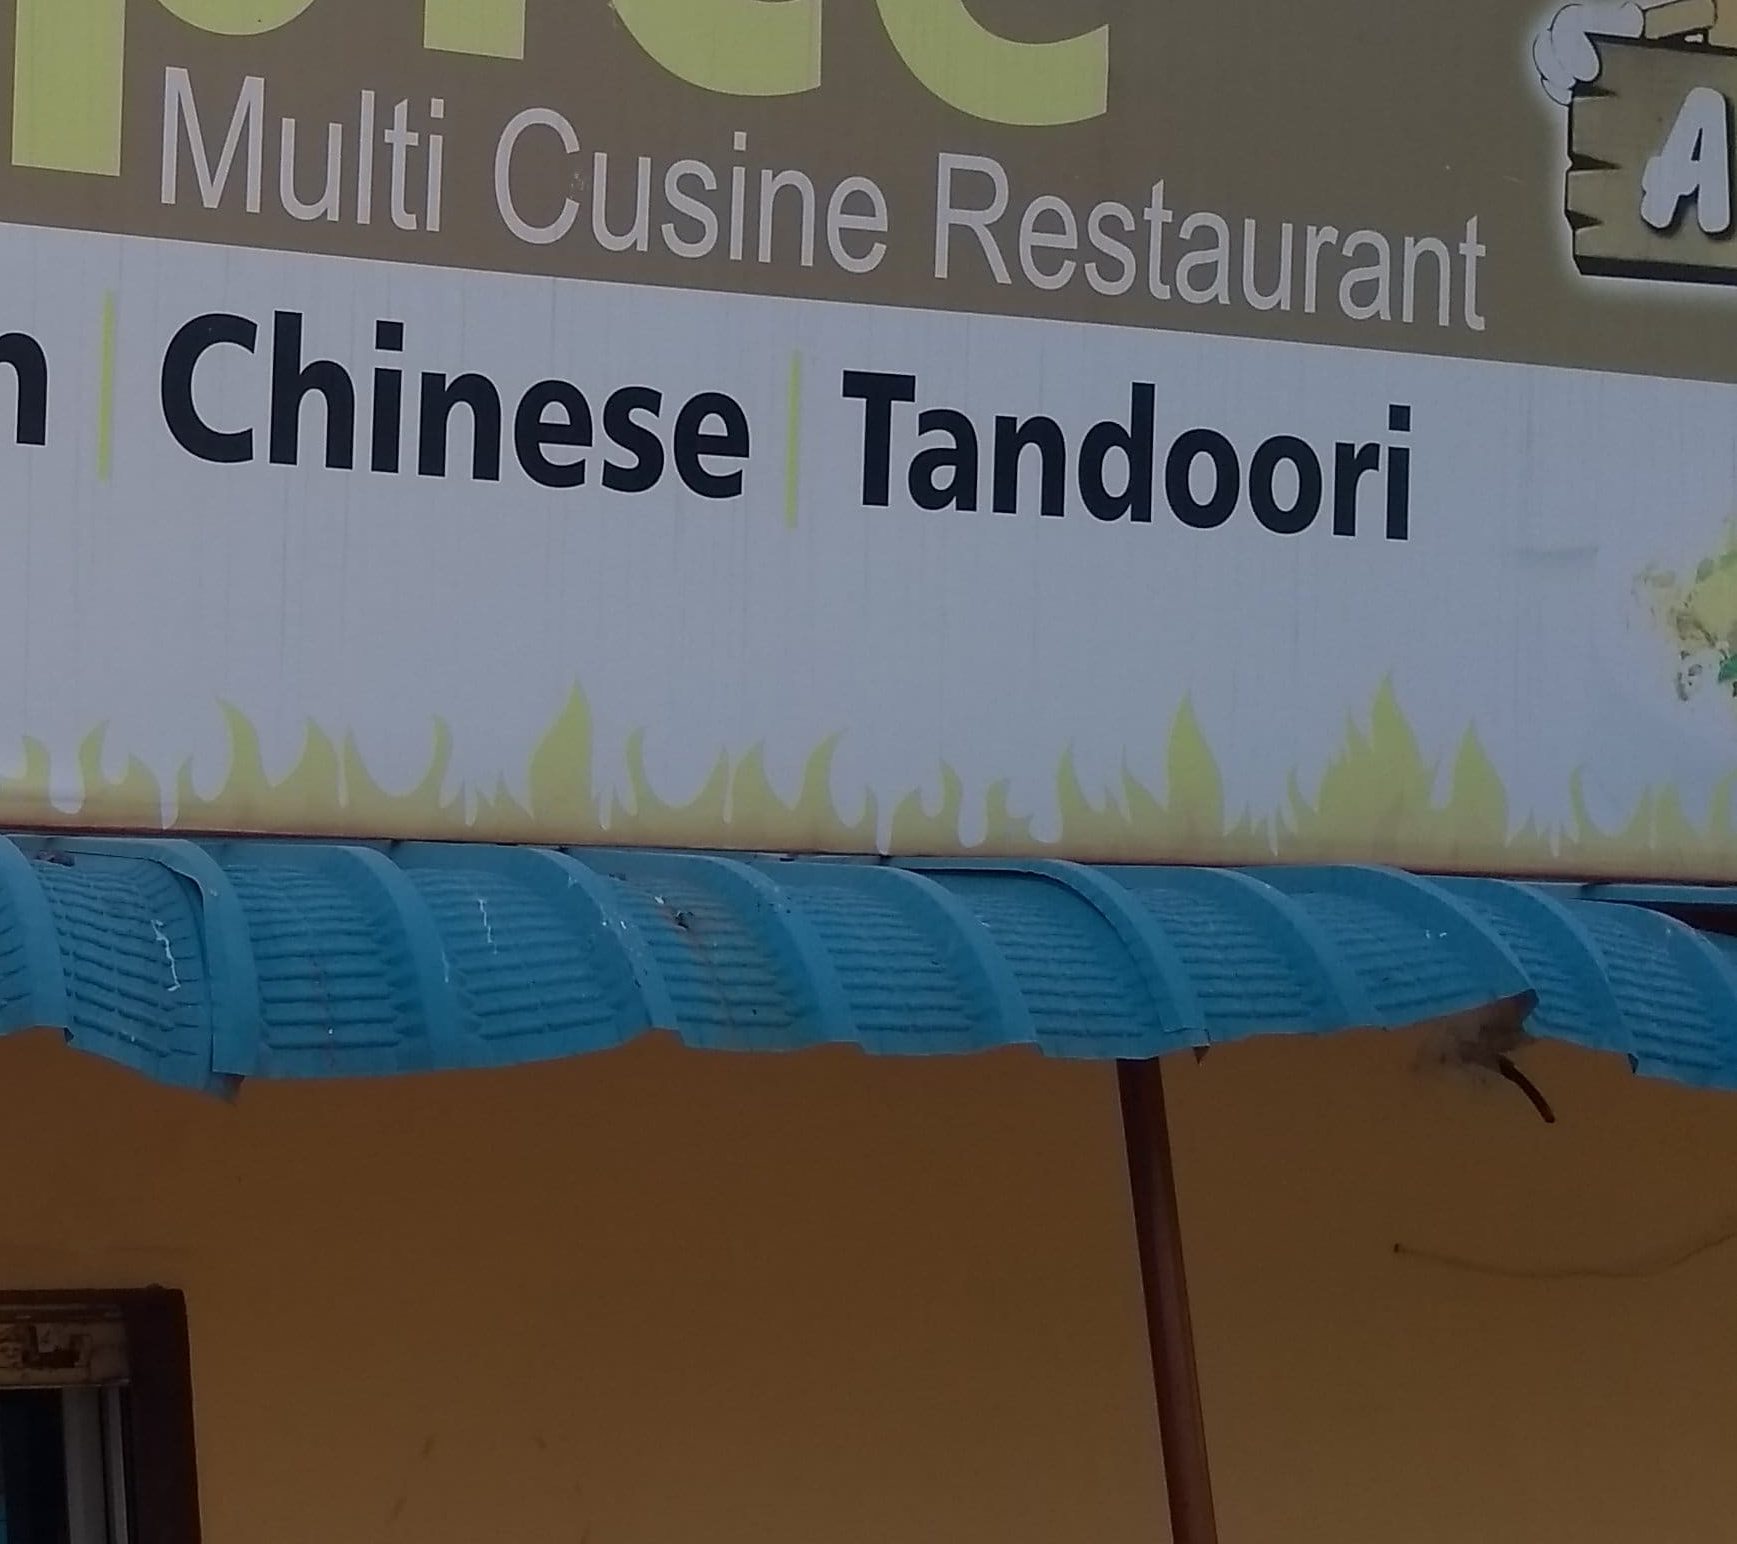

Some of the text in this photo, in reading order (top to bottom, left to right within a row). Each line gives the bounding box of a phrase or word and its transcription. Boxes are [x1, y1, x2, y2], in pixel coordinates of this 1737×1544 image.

[161, 66, 1485, 331] Multi Cusine Restaurant
[161, 310, 750, 499] Chinese
[842, 370, 1411, 541] Tandoori
